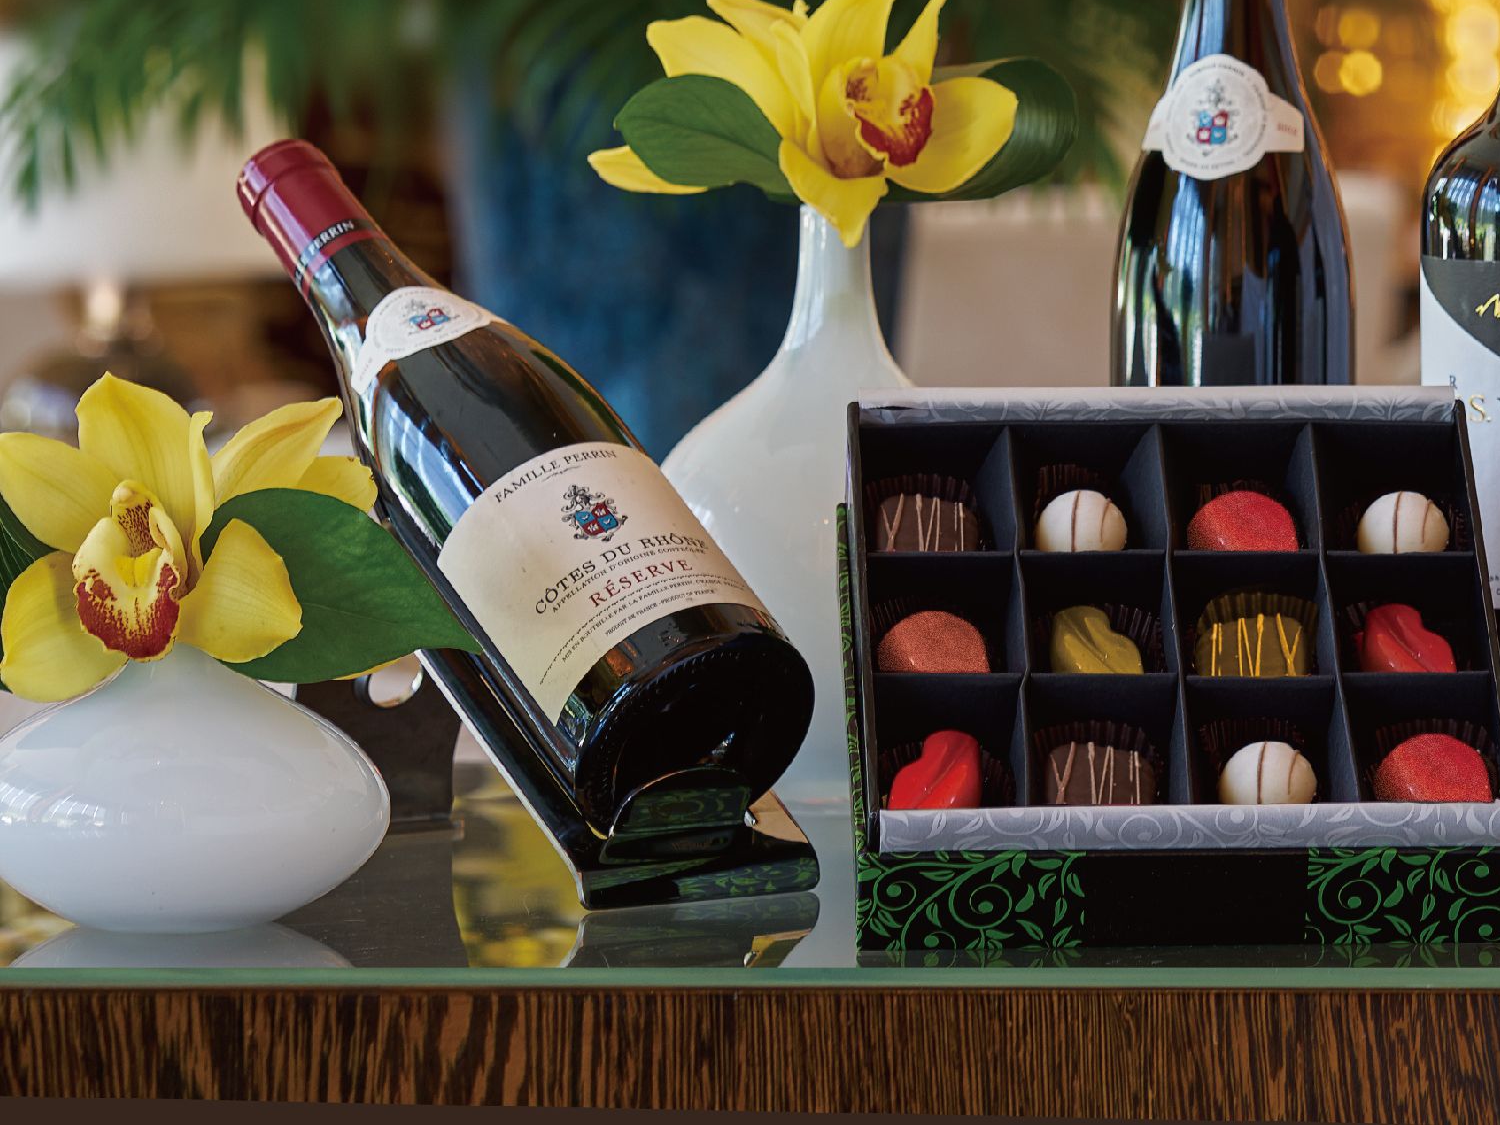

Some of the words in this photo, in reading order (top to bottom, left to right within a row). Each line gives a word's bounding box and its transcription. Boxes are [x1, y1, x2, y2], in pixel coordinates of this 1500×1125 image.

[495, 460, 560, 503] FAMILLE
[563, 450, 617, 464] PERRIN
[535, 560, 596, 614] CÔTES
[600, 543, 631, 564] DU
[638, 532, 708, 550] RHÔNE
[552, 568, 607, 613] APPELLATION
[588, 559, 693, 608] RÉSERVE
